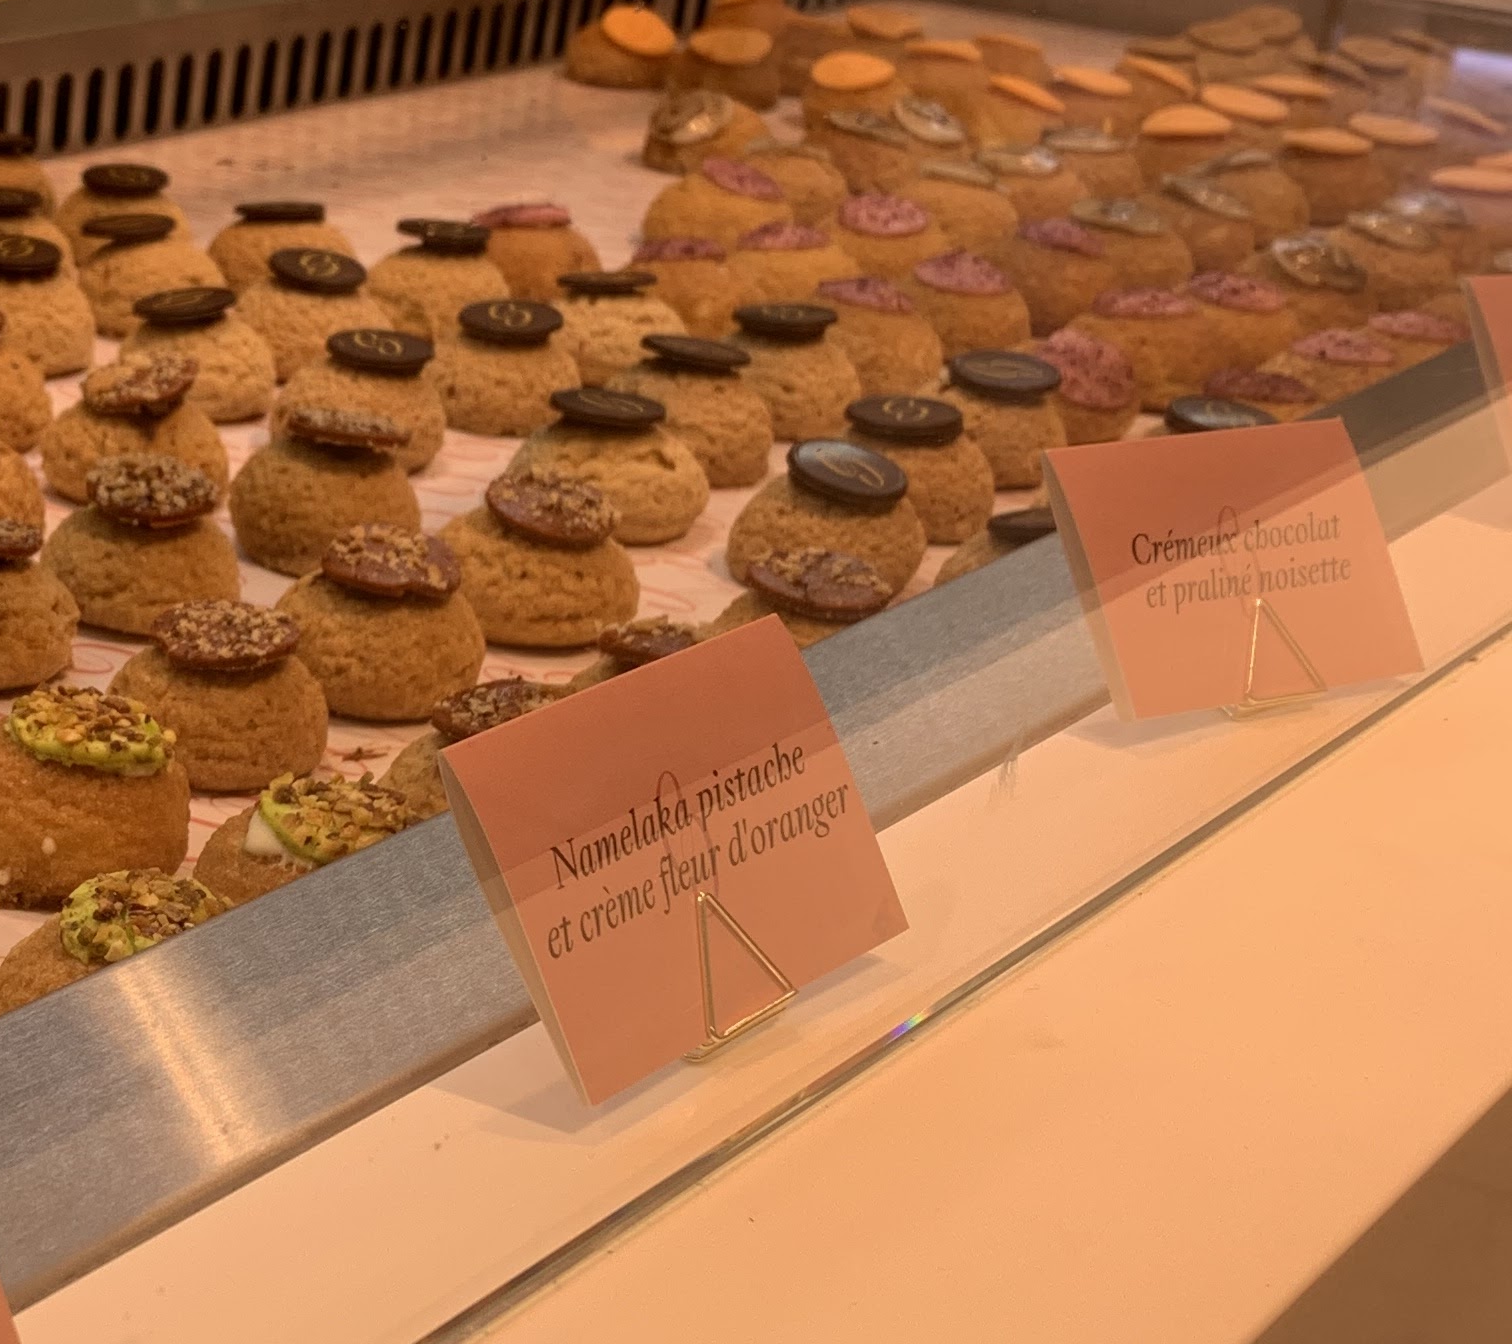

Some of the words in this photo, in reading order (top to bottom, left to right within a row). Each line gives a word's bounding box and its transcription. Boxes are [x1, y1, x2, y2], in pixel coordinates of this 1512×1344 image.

[1131, 528, 1238, 567] Crémeux
[1243, 511, 1342, 553] chocolat
[1145, 581, 1167, 609] et
[1172, 563, 1253, 616] praliné
[1258, 557, 1353, 595] noisette
[550, 796, 693, 890] Namelaka
[695, 742, 806, 833] pistache
[547, 916, 575, 960] et
[579, 885, 656, 943] crème
[659, 844, 721, 915] fleur
[727, 783, 850, 868] d'oranger
